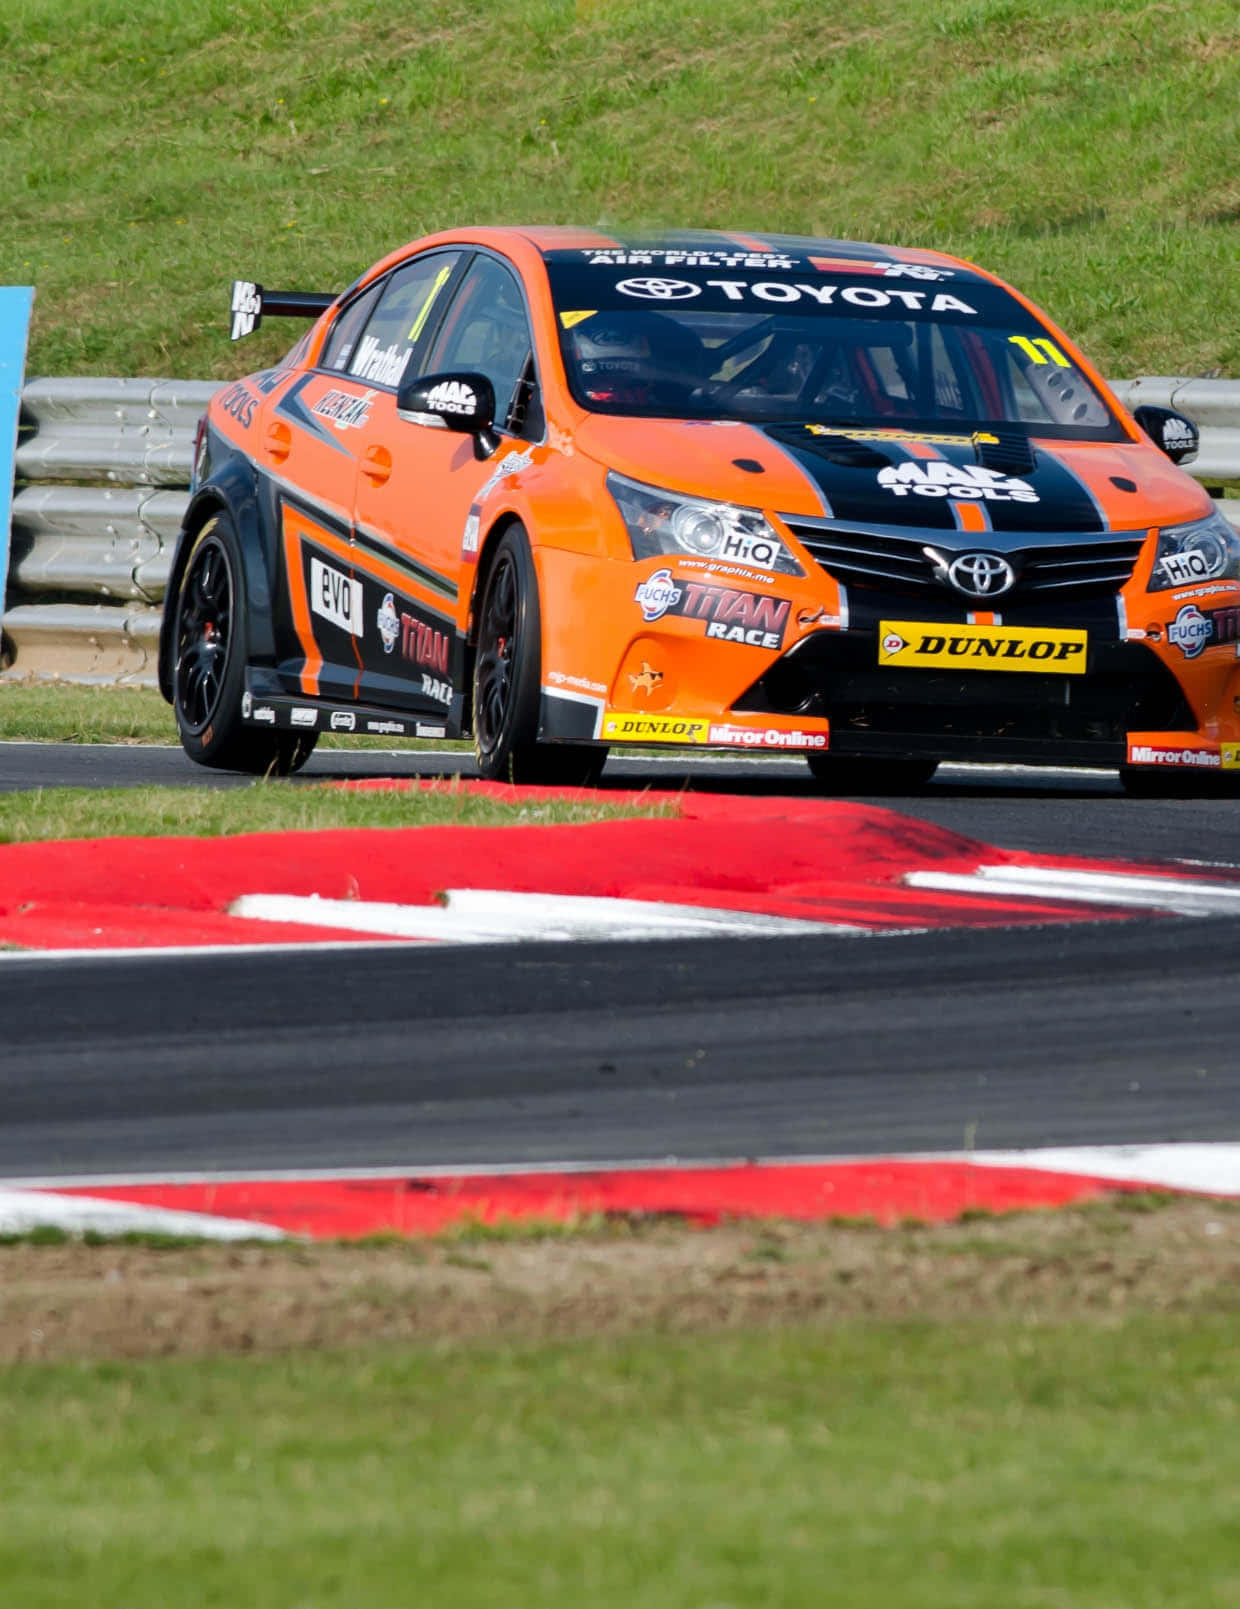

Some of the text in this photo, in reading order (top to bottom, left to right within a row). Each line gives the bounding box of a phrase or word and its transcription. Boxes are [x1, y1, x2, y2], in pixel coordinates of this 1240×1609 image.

[589, 256, 793, 269] AIR FILTER
[706, 280, 979, 314] TOYOTA
[1008, 335, 1072, 368] 11
[427, 381, 477, 405] MAC
[426, 401, 476, 415] TOOLS
[1164, 440, 1194, 450] TOOLS
[877, 462, 1036, 492] MAC
[882, 484, 1040, 503] TOOLS
[723, 535, 773, 565] HiQ
[1166, 555, 1207, 580] HiQ
[322, 567, 351, 622] evo
[638, 585, 680, 604] FUCHS
[707, 622, 781, 649] RACE
[1169, 620, 1212, 639] FUCHS
[915, 635, 1084, 661] DUNLOP
[620, 720, 704, 737] DUNLOP
